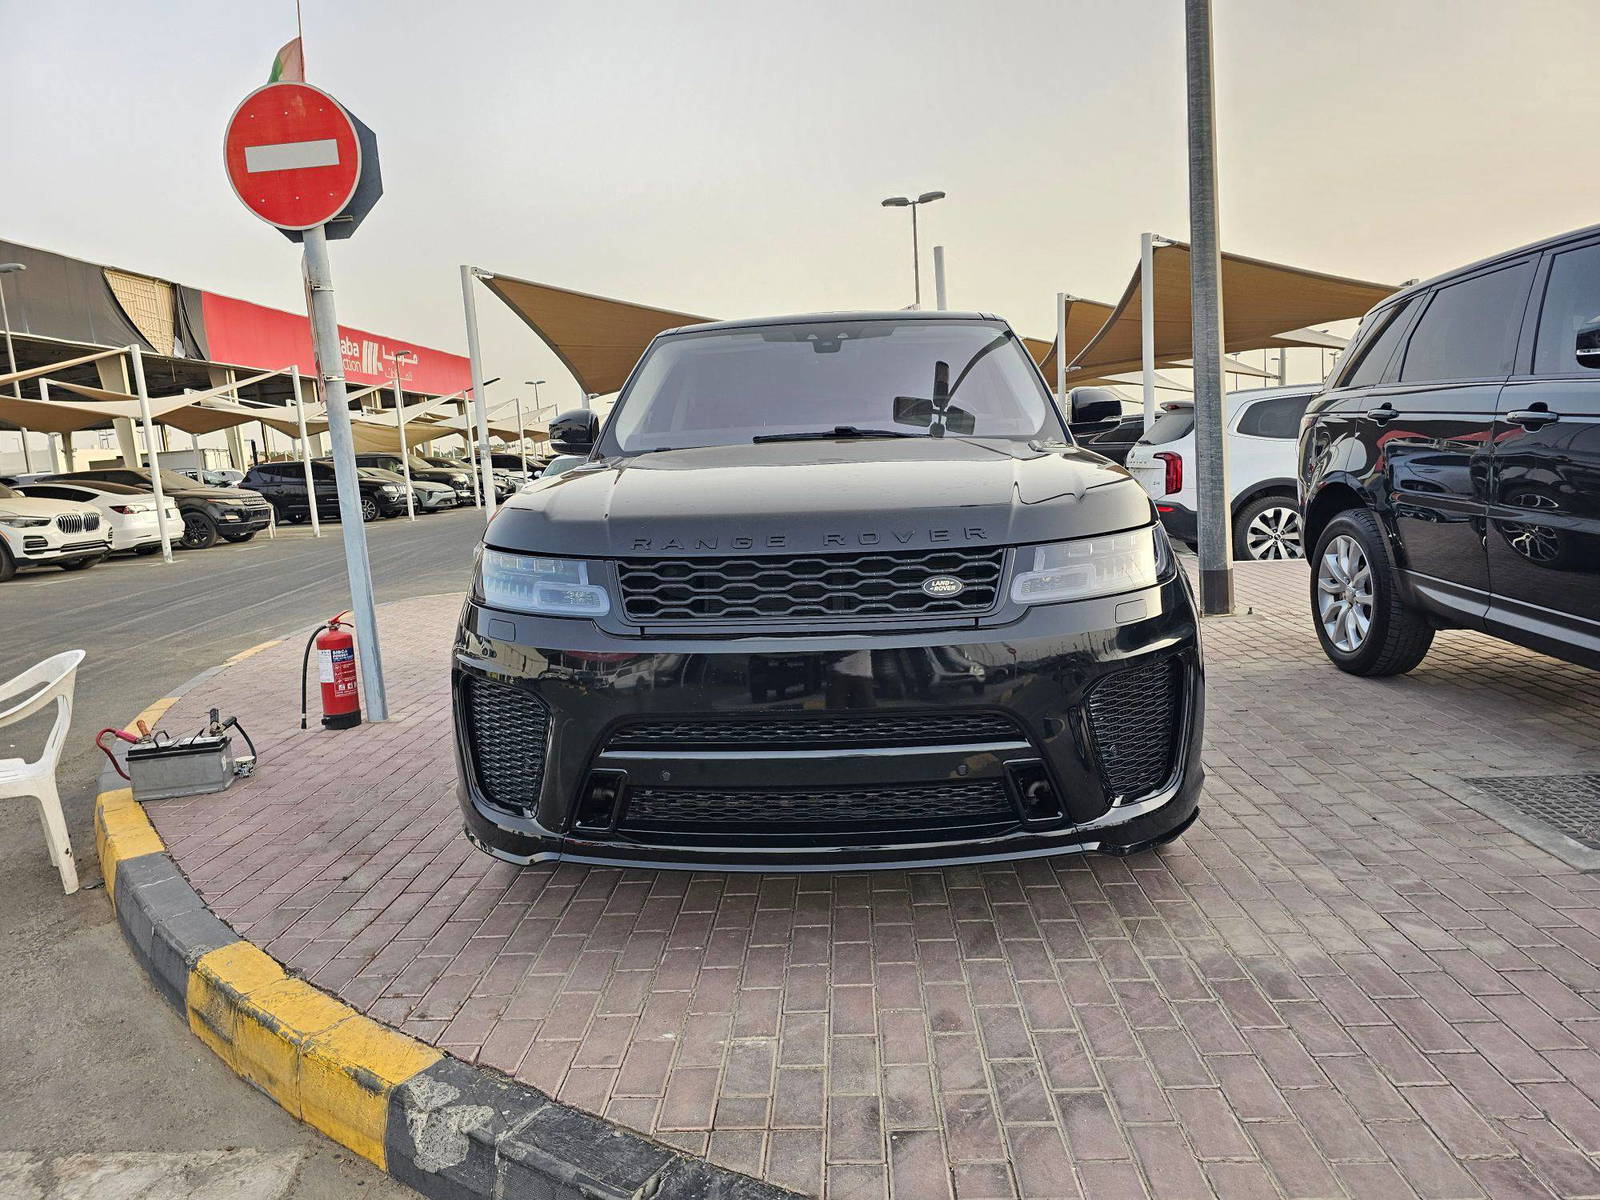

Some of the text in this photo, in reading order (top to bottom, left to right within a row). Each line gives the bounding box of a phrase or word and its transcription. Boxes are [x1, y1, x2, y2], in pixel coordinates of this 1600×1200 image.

[340, 336, 360, 357] aba
[342, 355, 362, 373] ction
[630, 527, 990, 551] RANGE ROVER
